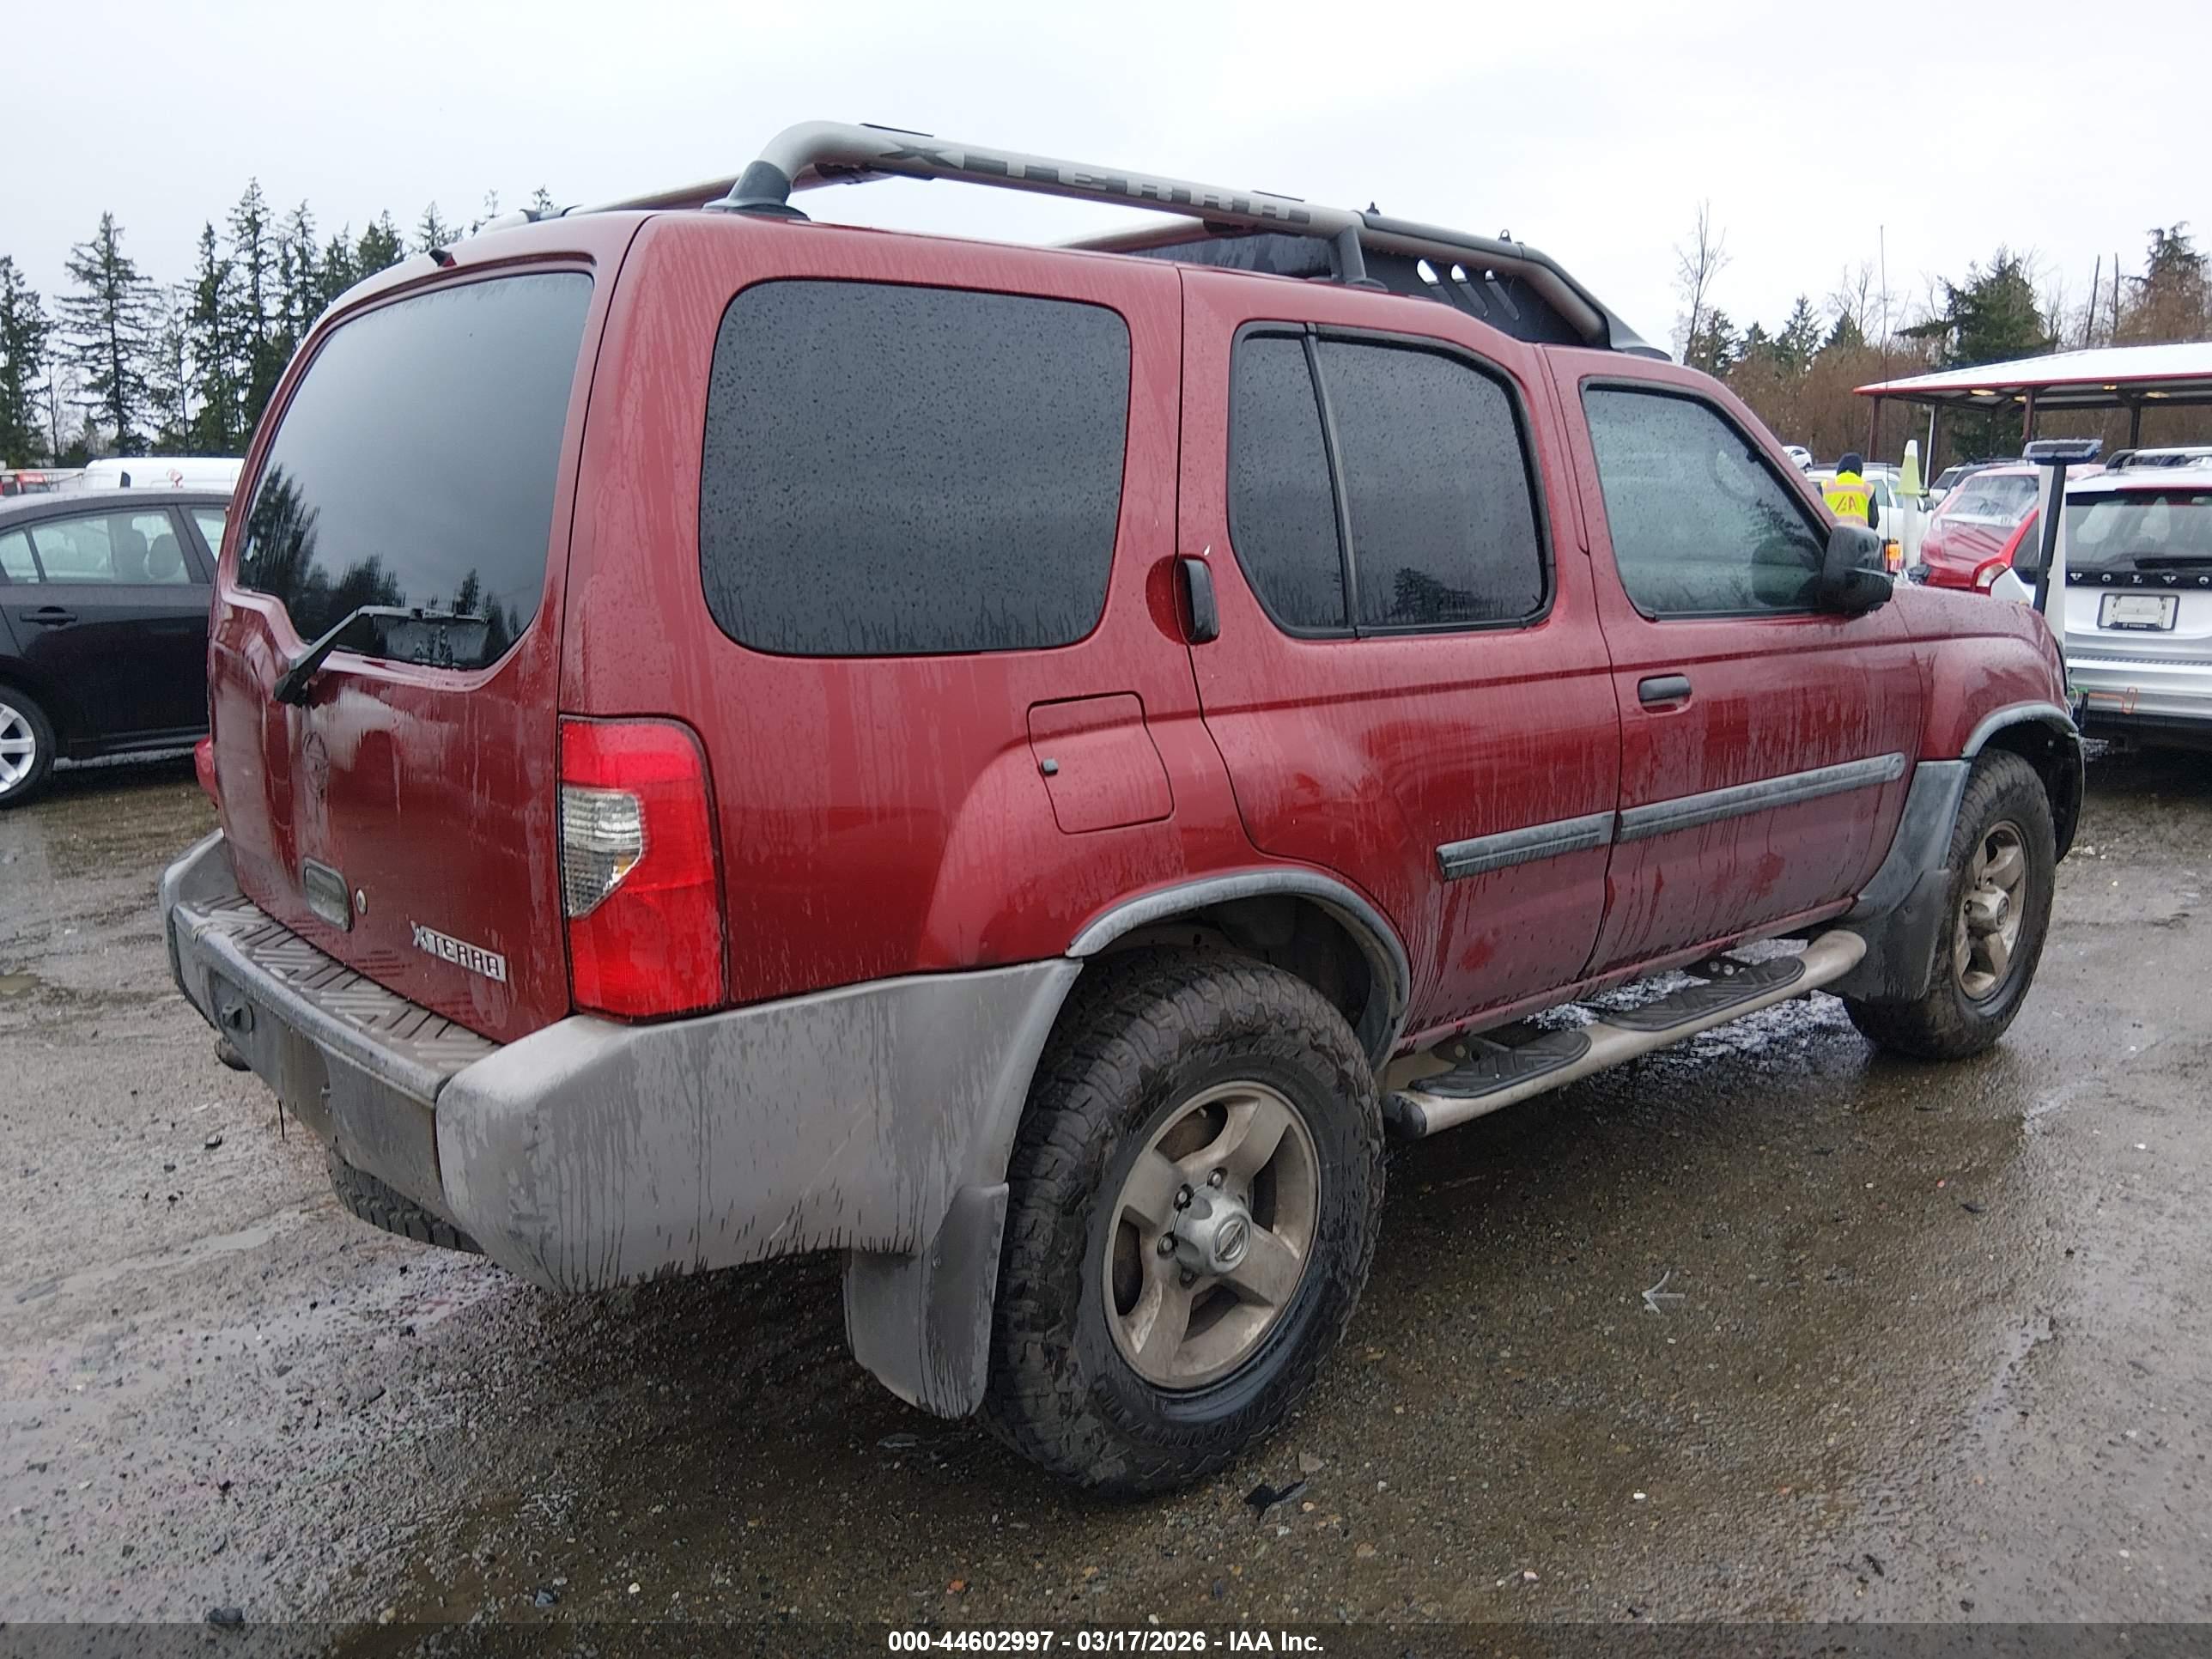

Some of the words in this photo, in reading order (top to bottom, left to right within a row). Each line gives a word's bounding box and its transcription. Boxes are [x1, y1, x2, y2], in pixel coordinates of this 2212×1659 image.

[878, 140, 1310, 225] XTERRA
[2069, 571, 2210, 586] VOLVO
[410, 920, 507, 982] XTERRA
